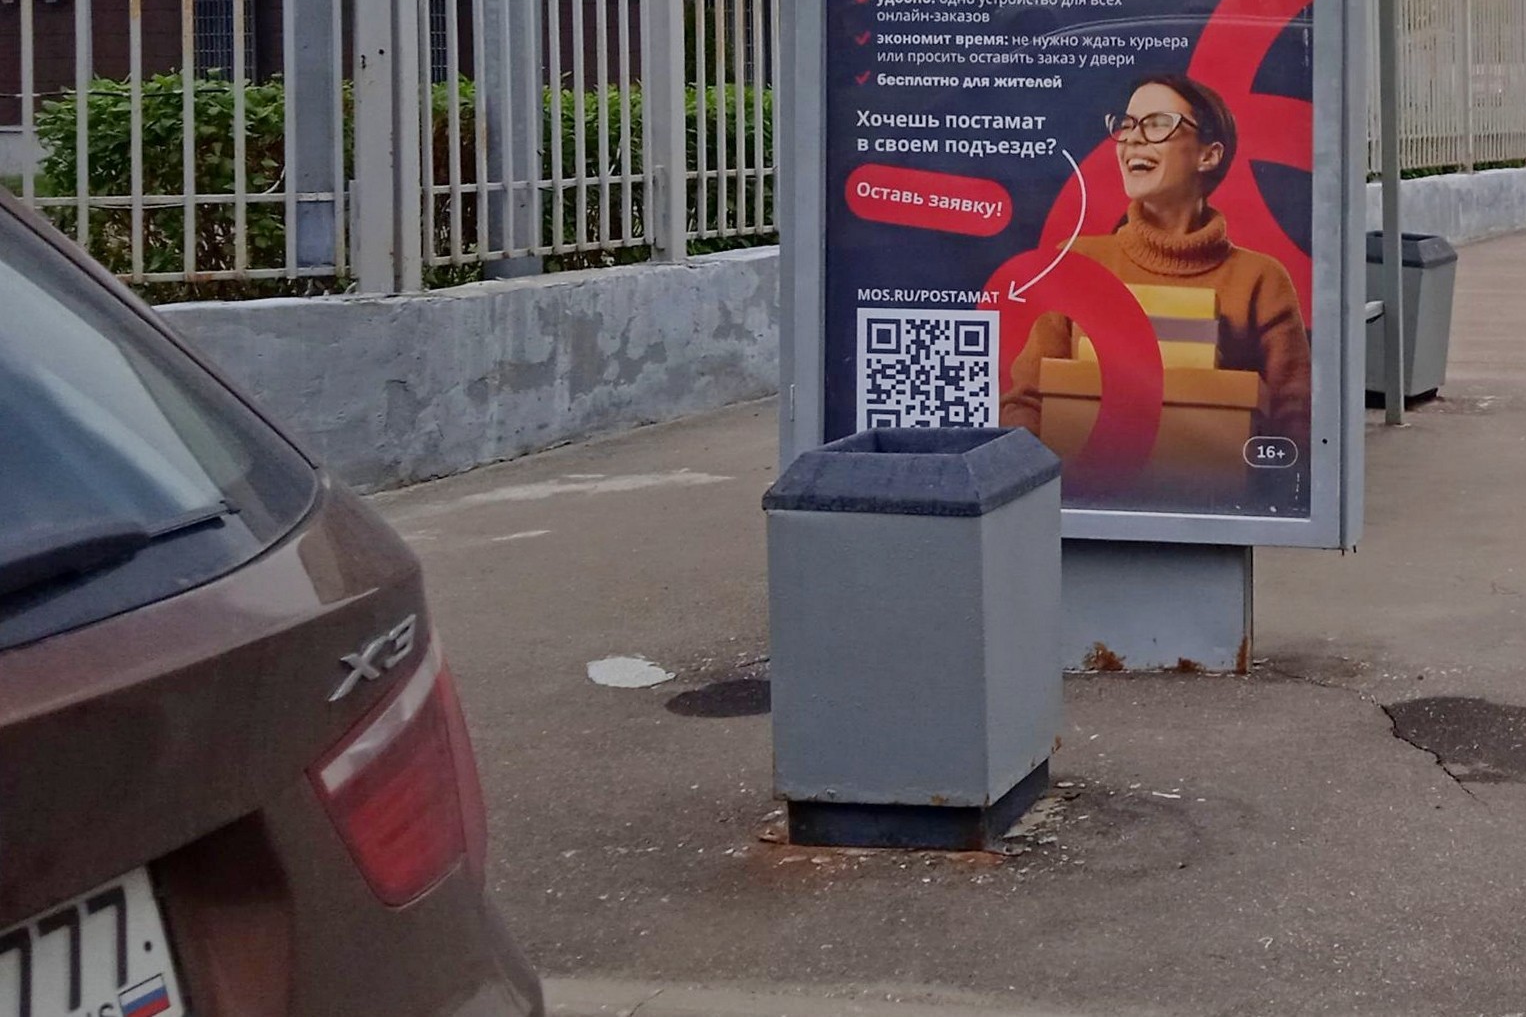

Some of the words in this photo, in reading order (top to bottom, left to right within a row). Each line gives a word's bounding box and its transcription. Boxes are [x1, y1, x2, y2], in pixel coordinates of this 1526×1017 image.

[876, 8, 990, 23] онлайн-заказов
[876, 33, 952, 45] экономит
[955, 34, 1009, 49] время:
[1011, 35, 1030, 47] не
[1032, 33, 1079, 50] нужно
[1081, 36, 1126, 49] ждать
[1129, 36, 1189, 51] курьера
[877, 52, 904, 63] или
[907, 52, 966, 66] просить
[969, 52, 1034, 64] оставить
[1037, 53, 1076, 65] заказ
[1078, 54, 1088, 69] у
[1089, 54, 1135, 69] двери
[877, 73, 960, 87] бесплатно
[962, 76, 990, 89] для
[993, 75, 1062, 89] жителей
[856, 110, 940, 128] Хочешь
[945, 114, 1047, 130] постамат
[857, 138, 869, 152] в
[874, 138, 939, 153] своем
[945, 137, 1057, 159] подъезде?
[856, 181, 924, 205] Оставь
[928, 194, 1003, 219] заявку!
[857, 288, 1000, 304] MOS.RU/POSTAMAT
[1256, 445, 1286, 459] 16+
